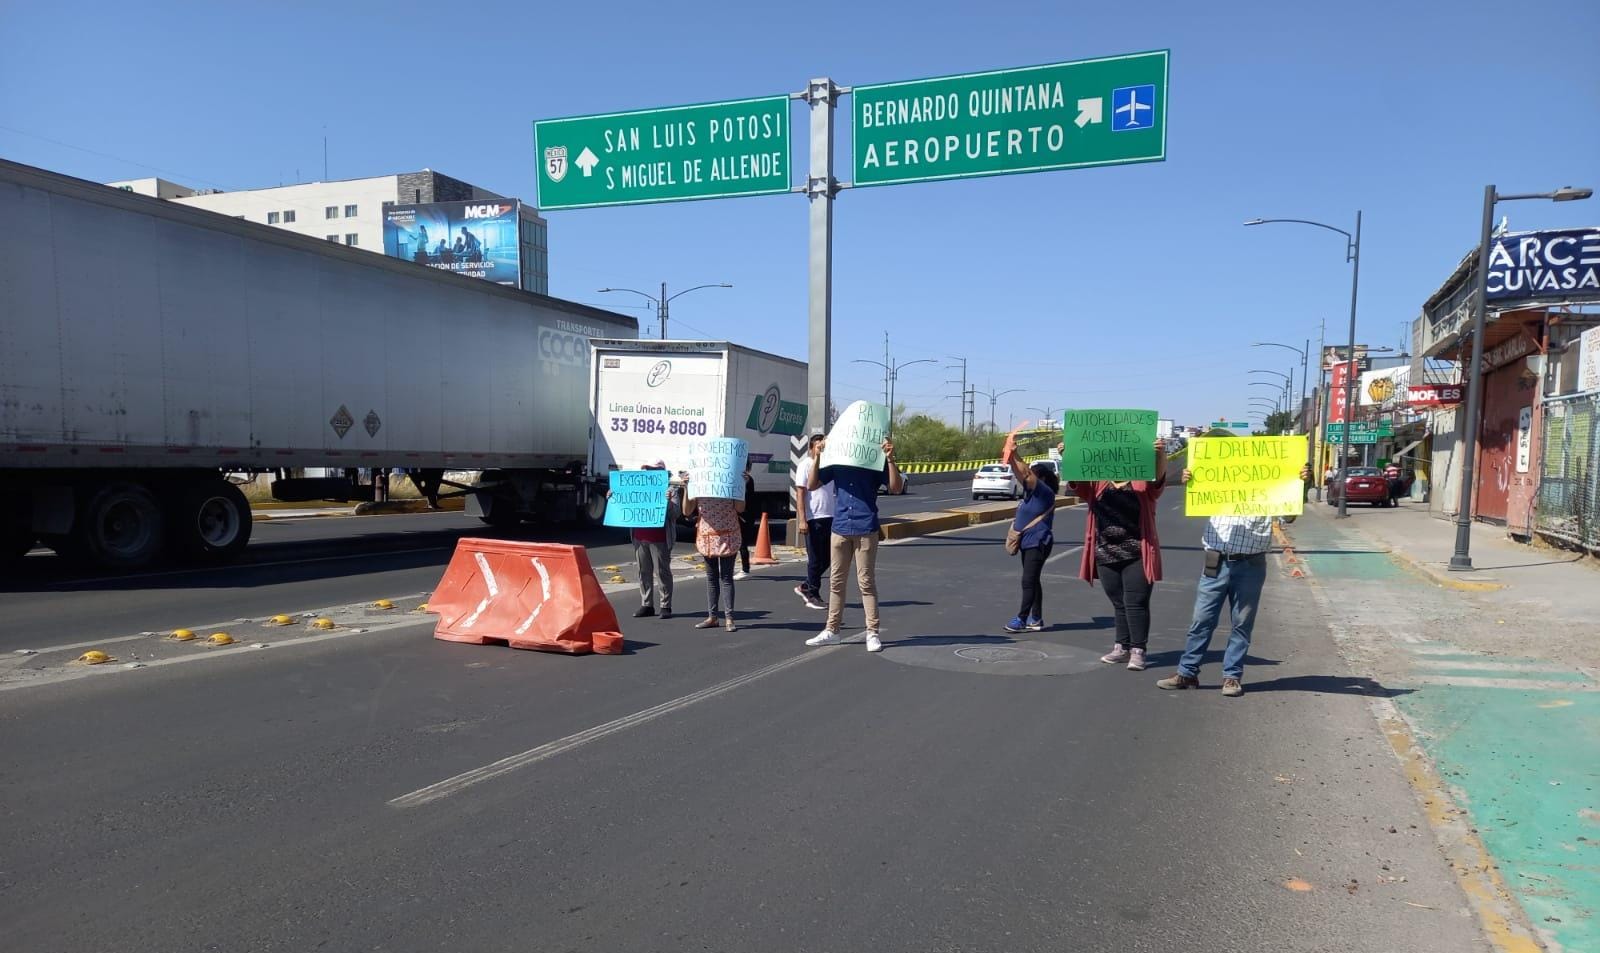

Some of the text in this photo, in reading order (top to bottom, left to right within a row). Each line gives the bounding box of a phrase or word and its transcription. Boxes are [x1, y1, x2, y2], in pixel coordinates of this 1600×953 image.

[863, 81, 1064, 128] BERNARDO QUINTANA
[604, 113, 781, 153] SAN LUIS POTOSI
[863, 124, 1064, 169] AEROPUERTO
[550, 158, 563, 174] 57
[606, 152, 781, 190] S MIGUEL DE ALLENDE
[464, 204, 499, 219] MCM
[460, 261, 495, 269] SERVICIOS
[1408, 388, 1461, 402] MOFLES
[636, 401, 662, 414] Única
[664, 405, 705, 417] Nacional
[611, 417, 707, 436] 33 1984 8080
[1069, 411, 1155, 427] AUTORIDADES
[1080, 429, 1141, 444] AUSENTES
[1082, 447, 1141, 465] DRENAJE
[1193, 440, 1289, 460] EL DRENAJE
[1080, 464, 1149, 479] PRESENTE
[1192, 464, 1281, 484] COLAPSADO
[619, 473, 664, 488] EXIGIMOS
[610, 491, 652, 505] SOLUCION
[1188, 488, 1268, 506] TAMBIEN ES
